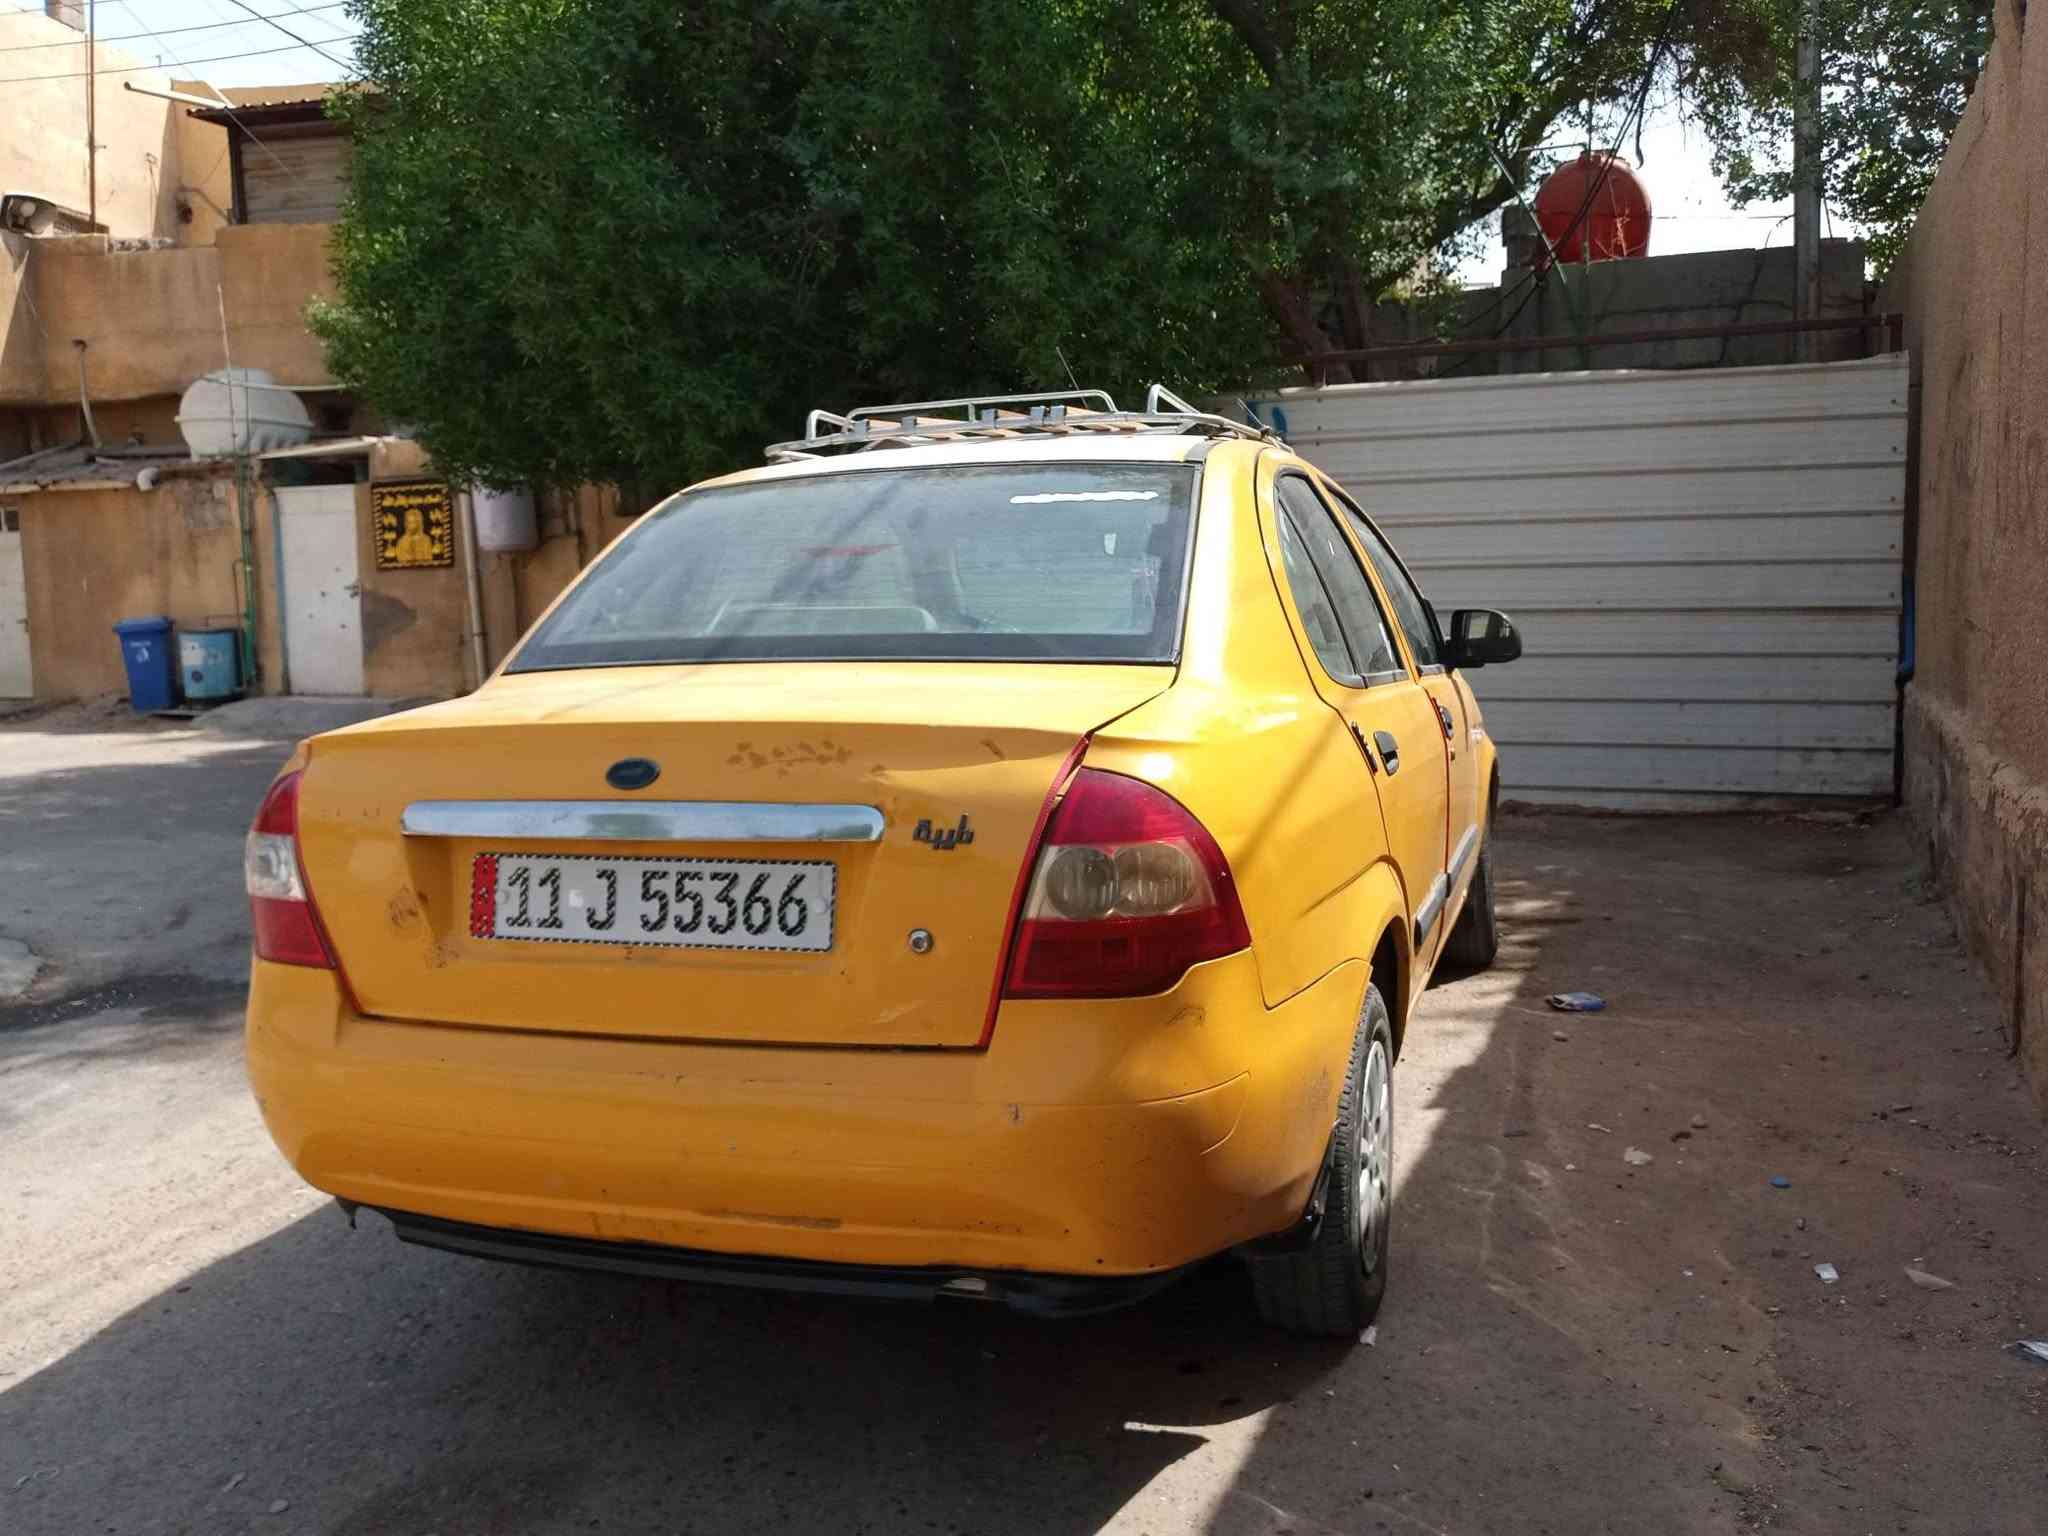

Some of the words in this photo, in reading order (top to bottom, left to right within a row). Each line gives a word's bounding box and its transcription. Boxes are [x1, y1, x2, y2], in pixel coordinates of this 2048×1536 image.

[912, 814, 975, 851] طيبة
[506, 866, 563, 929] 11
[586, 868, 617, 931] J
[640, 869, 808, 937] 55366
